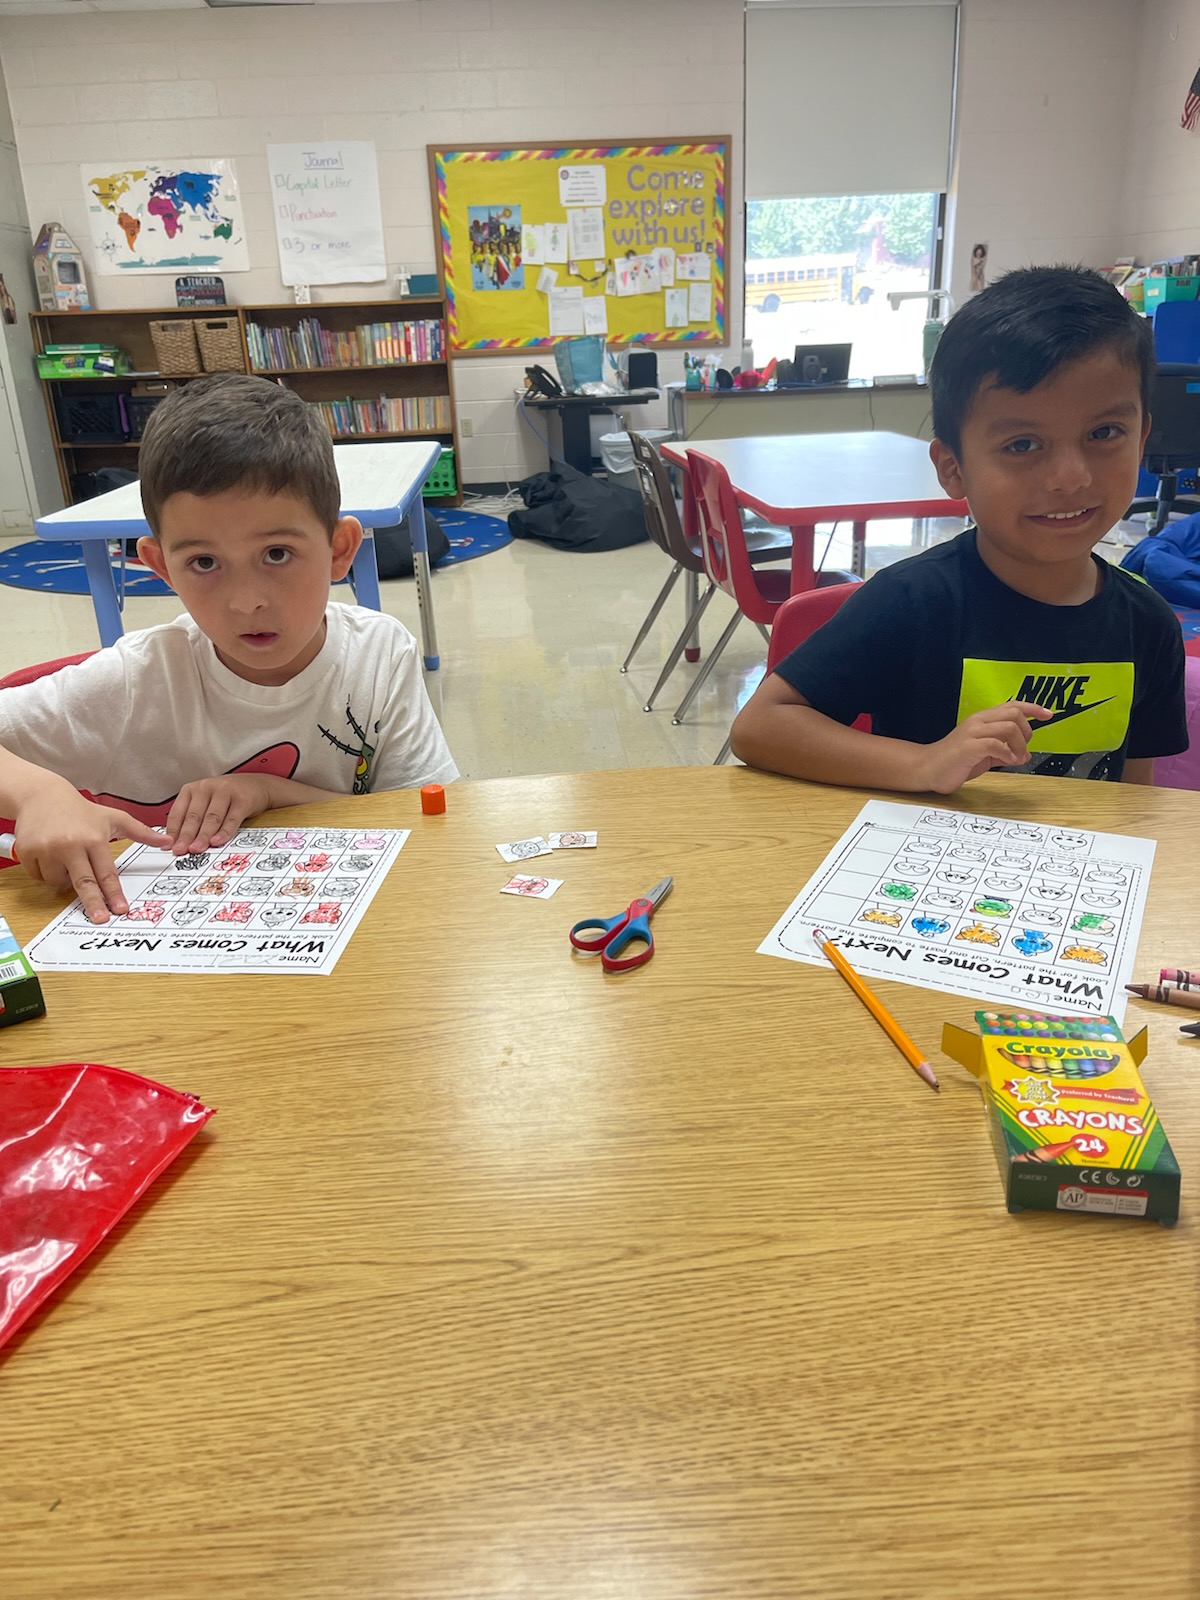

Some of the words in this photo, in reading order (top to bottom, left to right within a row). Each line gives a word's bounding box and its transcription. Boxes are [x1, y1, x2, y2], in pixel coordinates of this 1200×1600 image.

[301, 151, 344, 168] Journal
[627, 164, 704, 191] Come
[286, 173, 320, 197] Capital
[323, 173, 354, 189] Letter
[288, 203, 338, 222] Punctuation
[608, 191, 705, 224] explore
[612, 219, 668, 246] with
[673, 218, 705, 244] us!
[292, 237, 305, 254] 3
[310, 243, 321, 251] or
[327, 240, 352, 250] more
[1015, 675, 1091, 710] NIKE
[838, 928, 855, 936] the
[858, 931, 903, 945] complete
[79, 938, 162, 951] Next?
[169, 939, 248, 953] Comes
[256, 940, 325, 953] What
[919, 945, 948, 954] paste
[278, 955, 320, 964] Name
[949, 949, 968, 957] and
[971, 954, 989, 962] Cut
[923, 953, 1010, 979] Comes
[993, 958, 1036, 972] pattern.
[1060, 972, 1079, 980] for
[1082, 975, 1109, 986] Look
[1022, 973, 1104, 1000] What
[1053, 994, 1102, 1011] Name
[1006, 1041, 1110, 1059] Crayola
[1061, 1089, 1093, 1097] Preferred
[1093, 1091, 1102, 1099] by
[1017, 1108, 1144, 1135] CRAYONS
[1075, 1138, 1104, 1153] 24
[1065, 1193, 1083, 1203] AP
